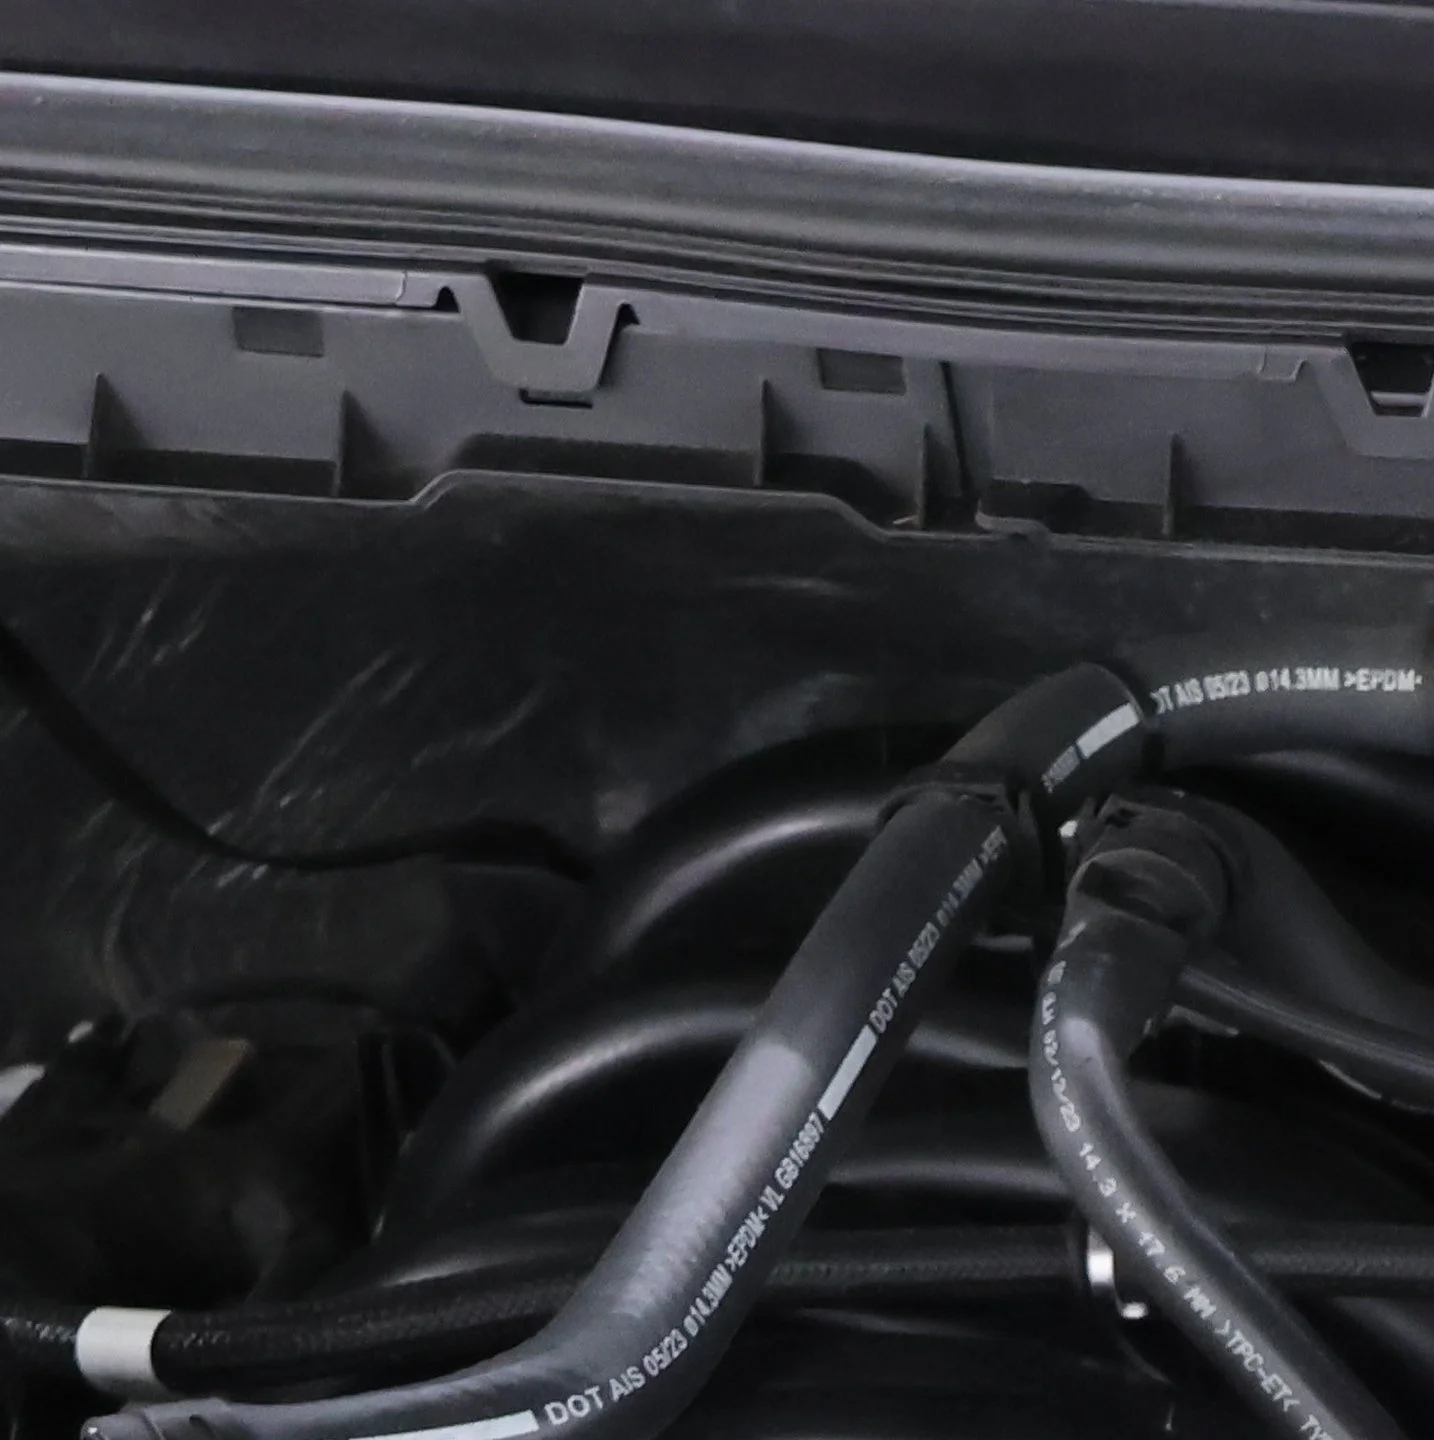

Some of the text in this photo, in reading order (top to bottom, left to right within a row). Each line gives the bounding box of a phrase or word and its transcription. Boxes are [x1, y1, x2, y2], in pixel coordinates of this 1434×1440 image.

[542, 1383, 606, 1428] DOT
[607, 1364, 647, 1403] AIS
[641, 1328, 692, 1379] 05/23
